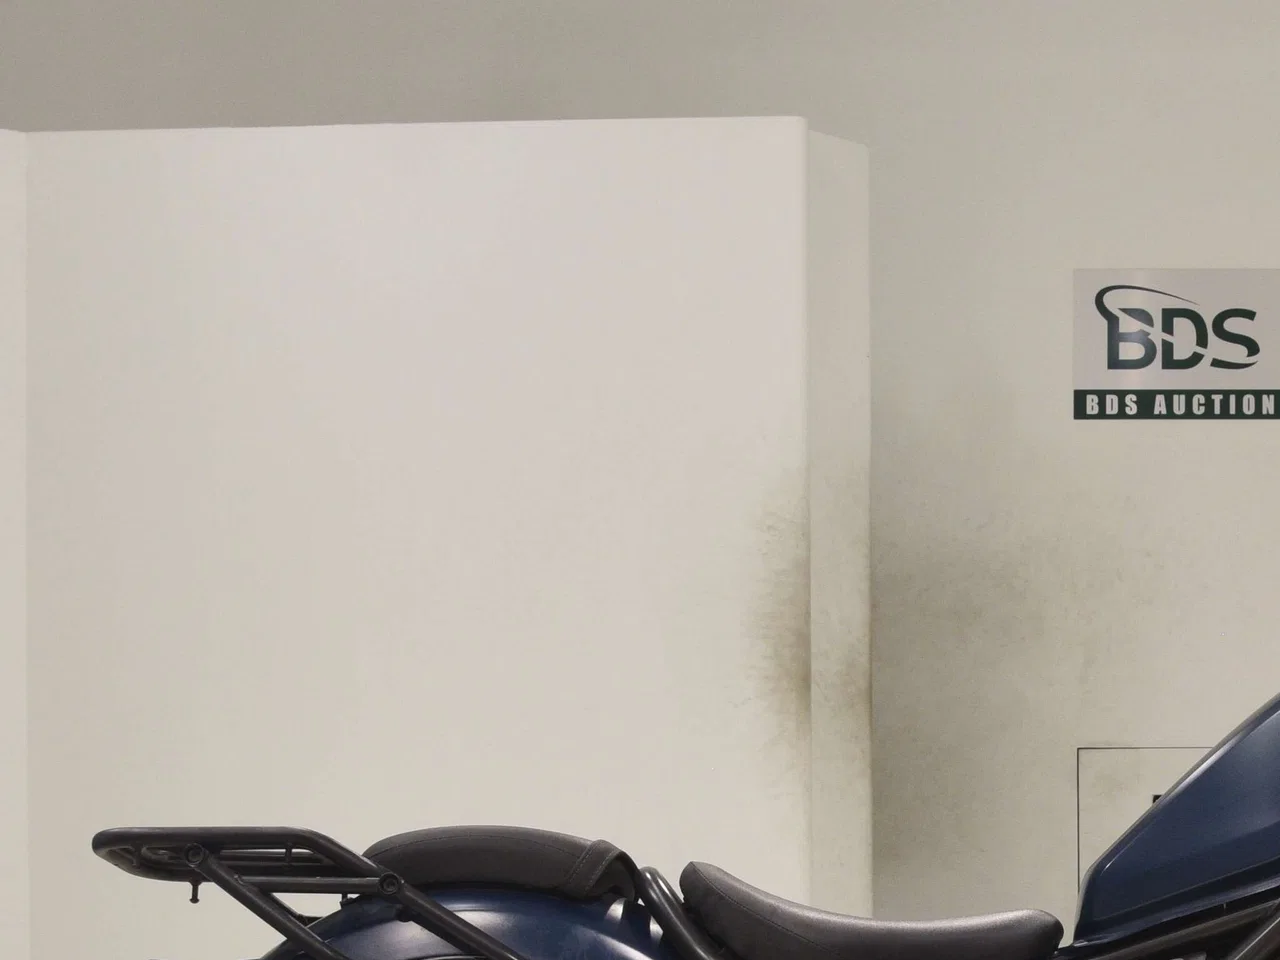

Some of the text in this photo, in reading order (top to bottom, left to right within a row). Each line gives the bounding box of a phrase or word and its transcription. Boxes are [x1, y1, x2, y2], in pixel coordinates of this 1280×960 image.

[1095, 285, 1260, 369] BDS
[1086, 394, 1275, 415] BDS AUCTION
